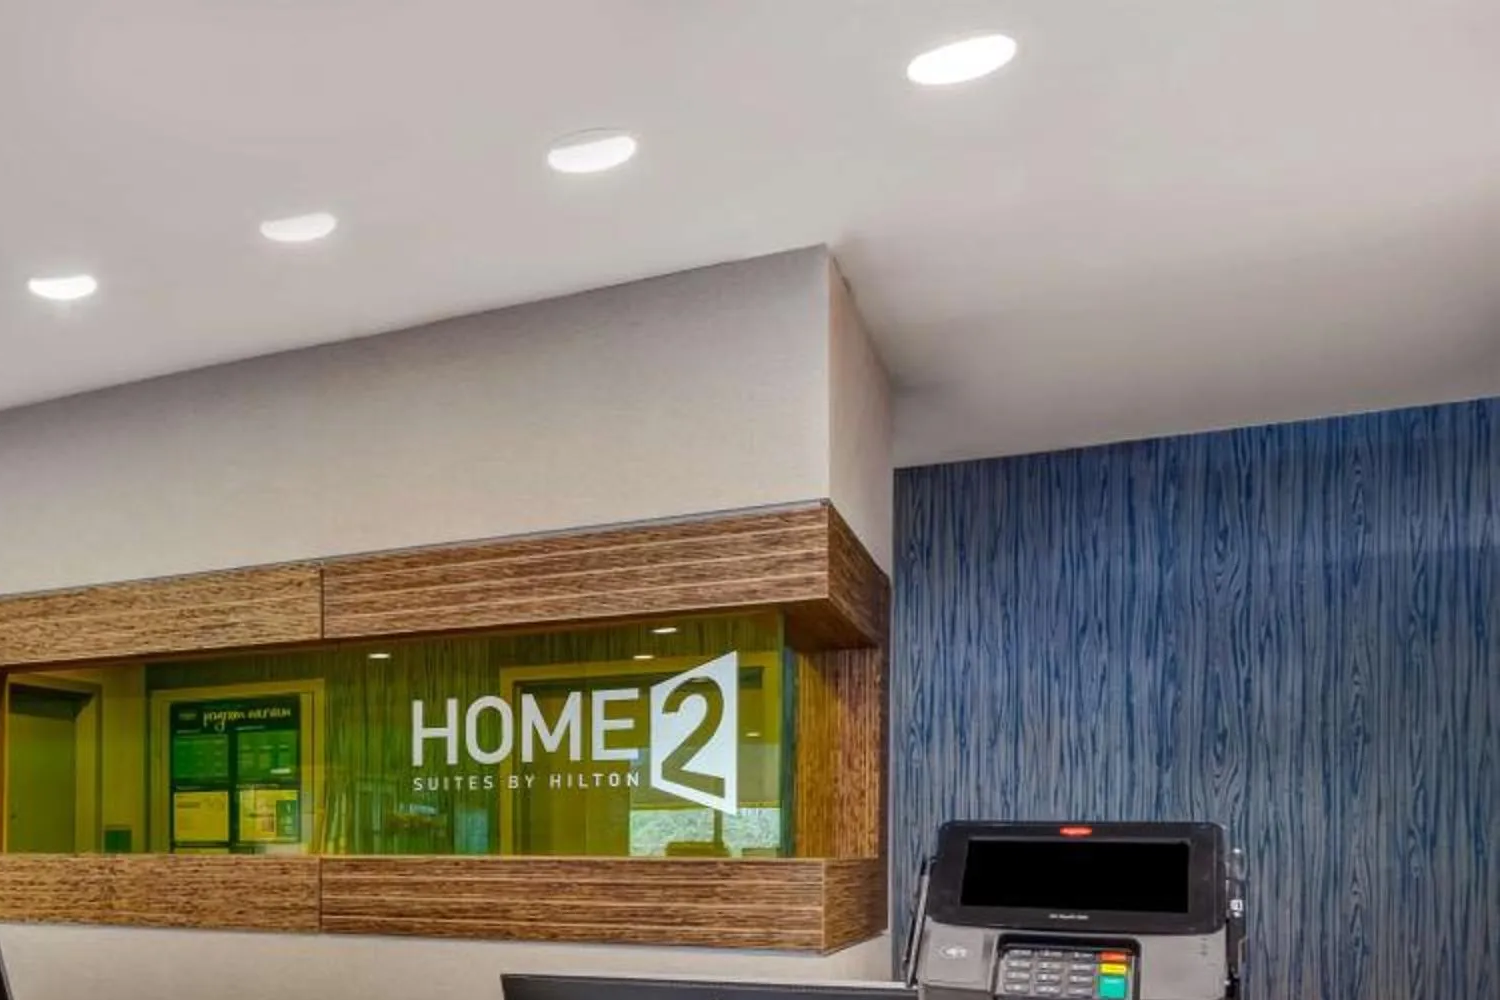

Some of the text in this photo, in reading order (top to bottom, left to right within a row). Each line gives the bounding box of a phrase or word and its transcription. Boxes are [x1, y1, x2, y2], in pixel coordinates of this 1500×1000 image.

[411, 687, 639, 767] HOME
[412, 772, 640, 792] SUITES BY HILTON
